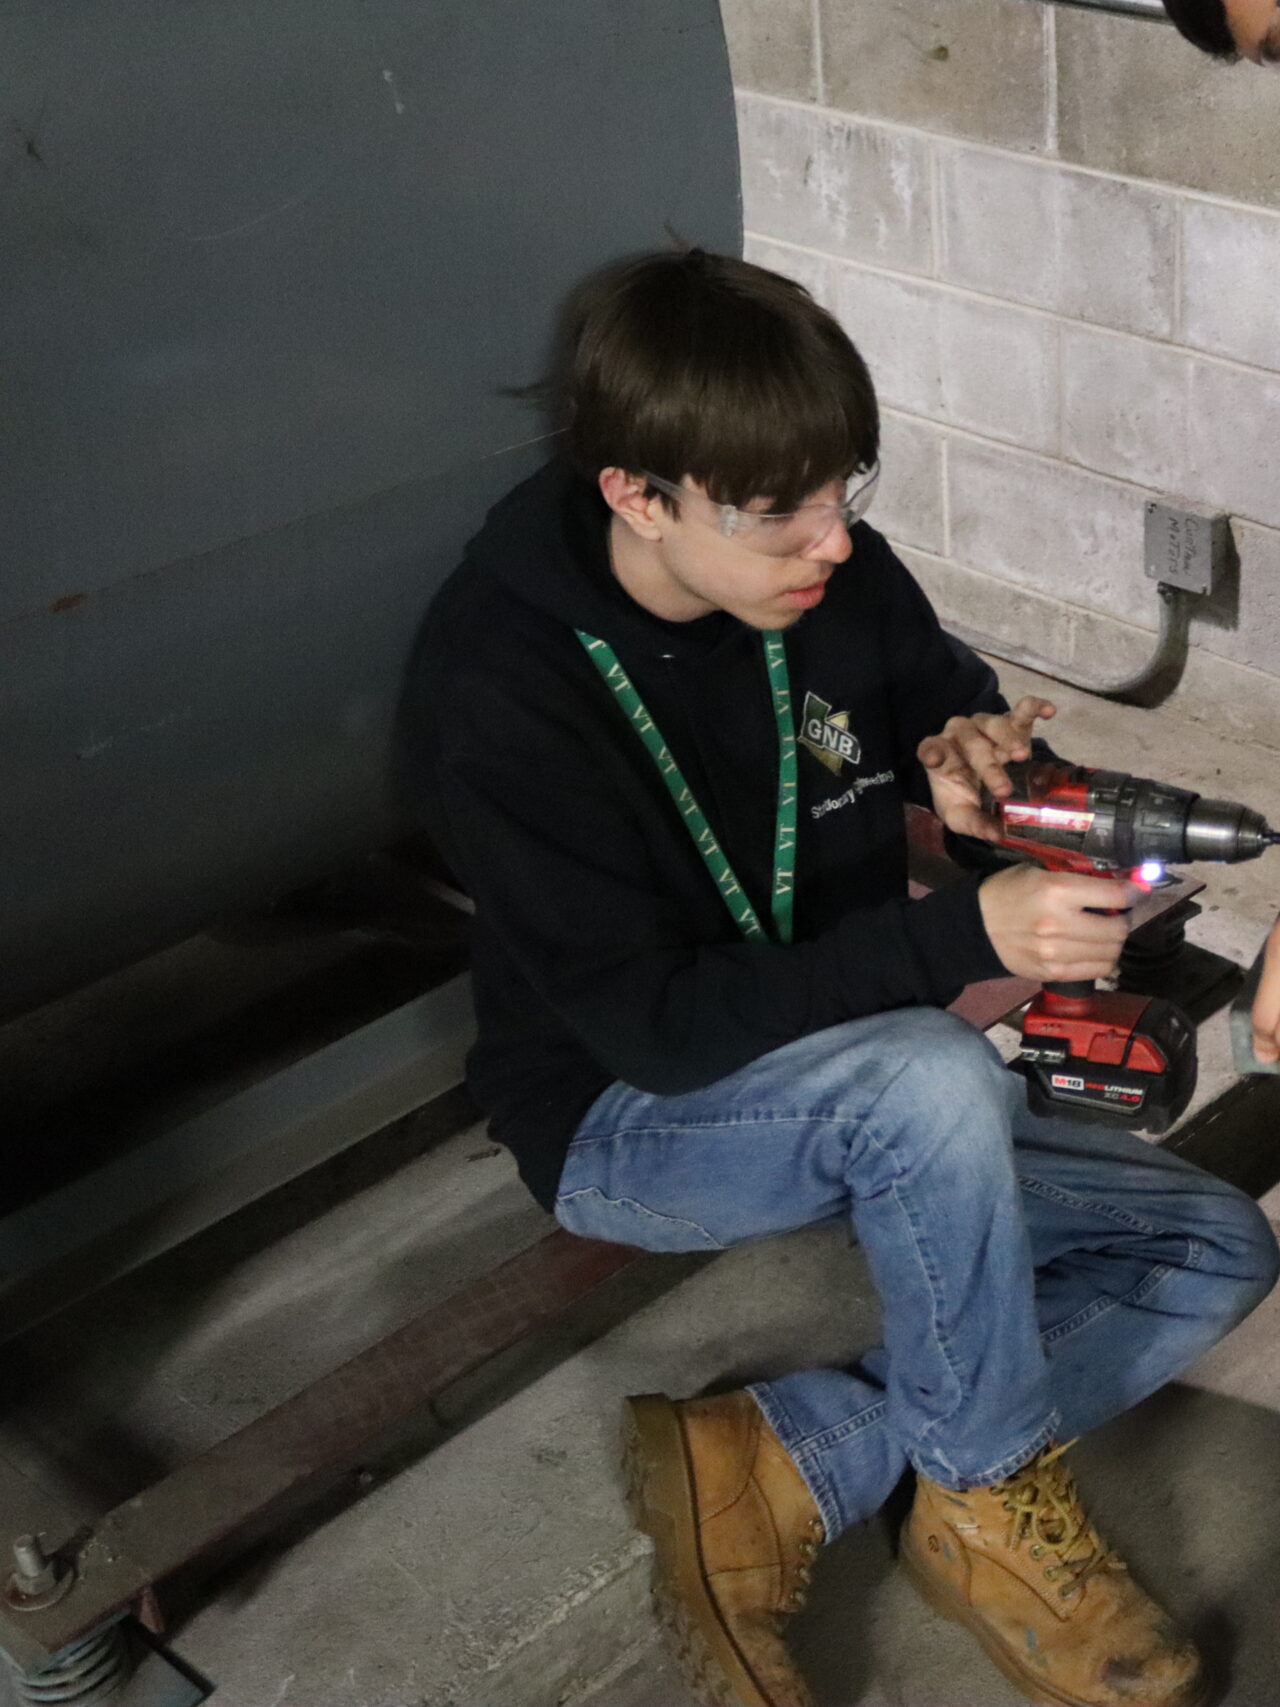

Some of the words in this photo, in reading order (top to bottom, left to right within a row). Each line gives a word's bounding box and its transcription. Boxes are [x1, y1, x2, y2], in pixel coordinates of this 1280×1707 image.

[767, 640, 784, 668] VT
[607, 662, 631, 692] VT
[632, 704, 655, 733] VT
[807, 718, 854, 757] GNB
[658, 747, 677, 773] VT
[679, 787, 699, 815] VT
[699, 828, 719, 856] VT
[779, 822, 796, 850] VT
[719, 868, 740, 896] VT
[775, 867, 793, 895] VT
[738, 908, 761, 934] VT
[1055, 1077, 1081, 1088] M18
